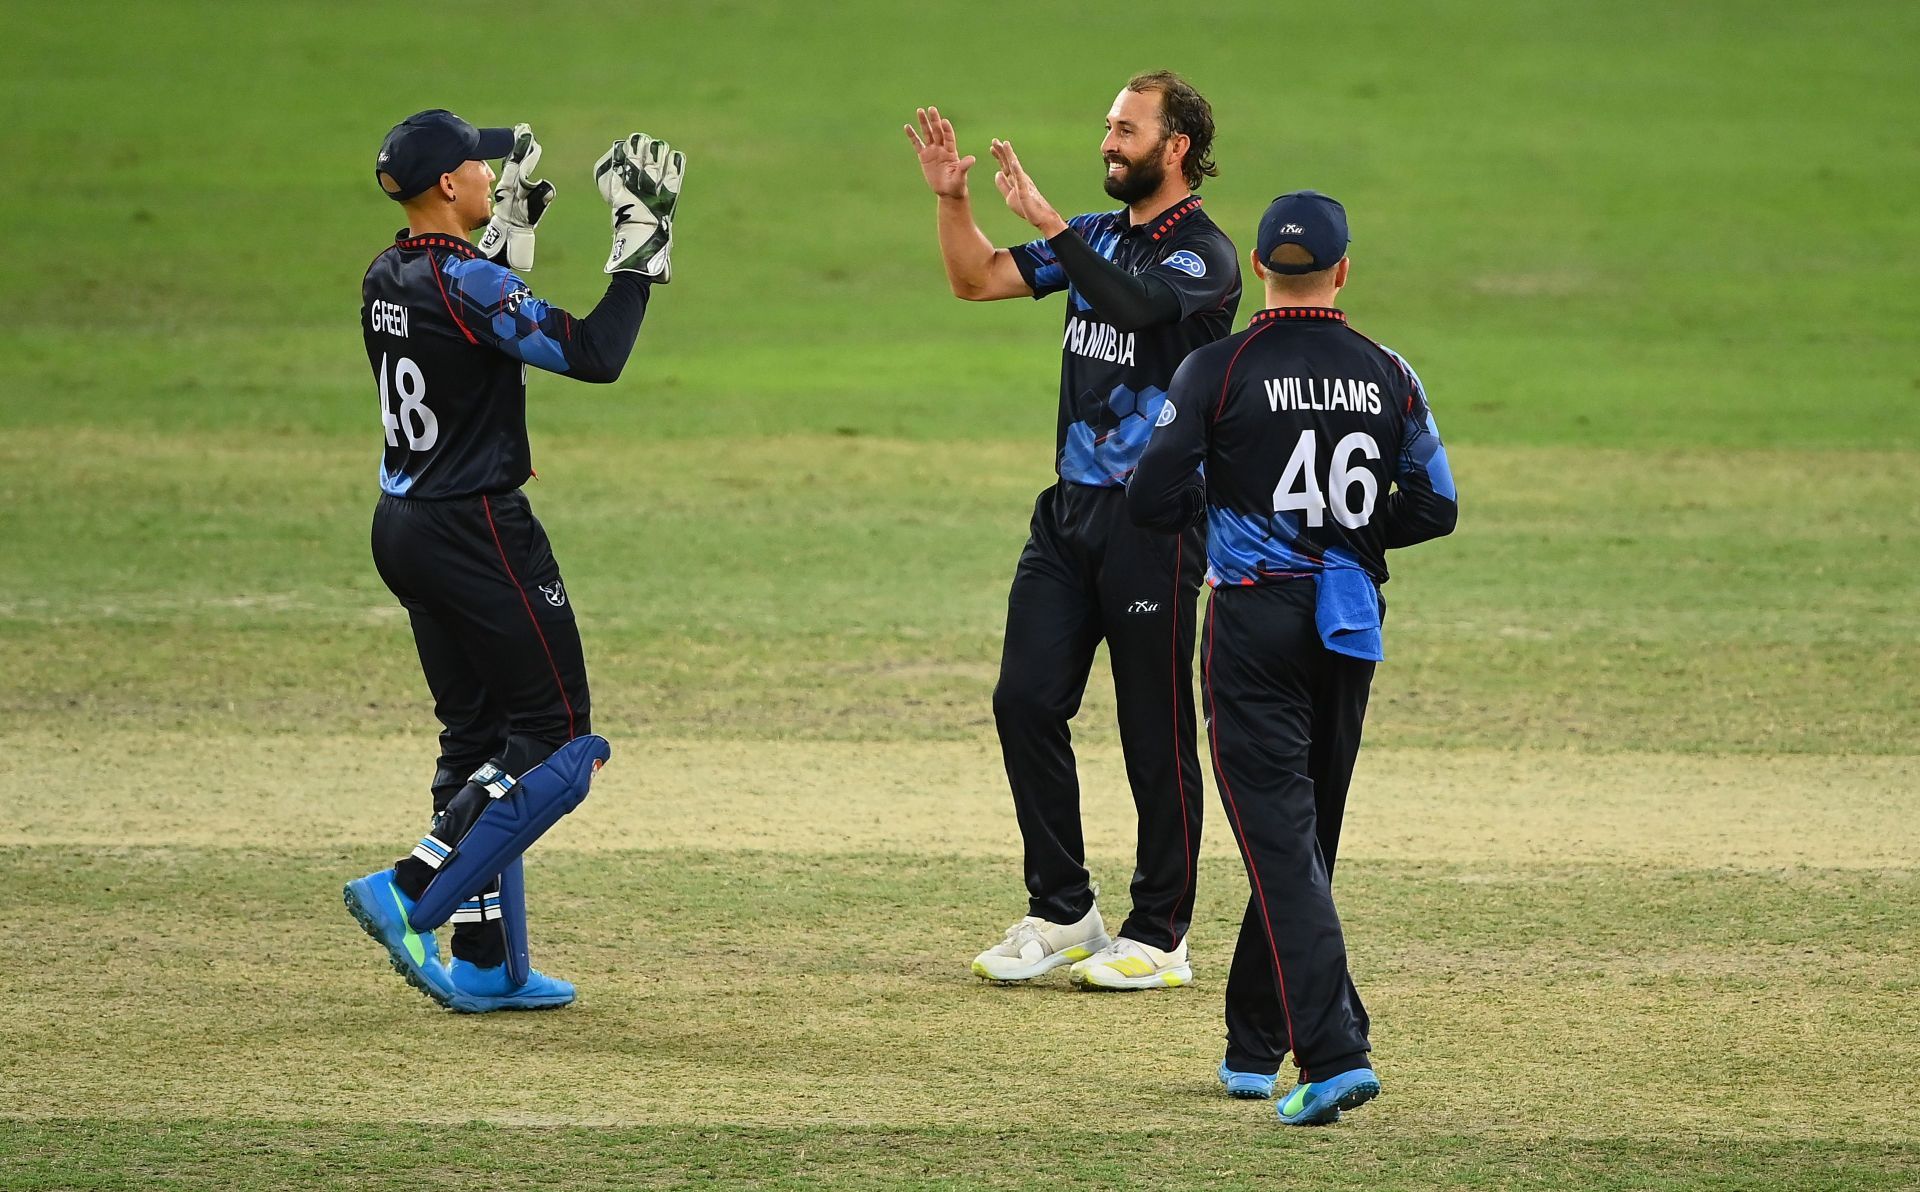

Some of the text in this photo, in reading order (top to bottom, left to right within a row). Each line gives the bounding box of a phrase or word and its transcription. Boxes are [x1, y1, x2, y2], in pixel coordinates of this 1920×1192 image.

[1062, 316, 1135, 367] NAMIBIA
[379, 351, 439, 451] 48
[1263, 377, 1382, 415] WILLIAMS
[1272, 429, 1381, 529] 46
